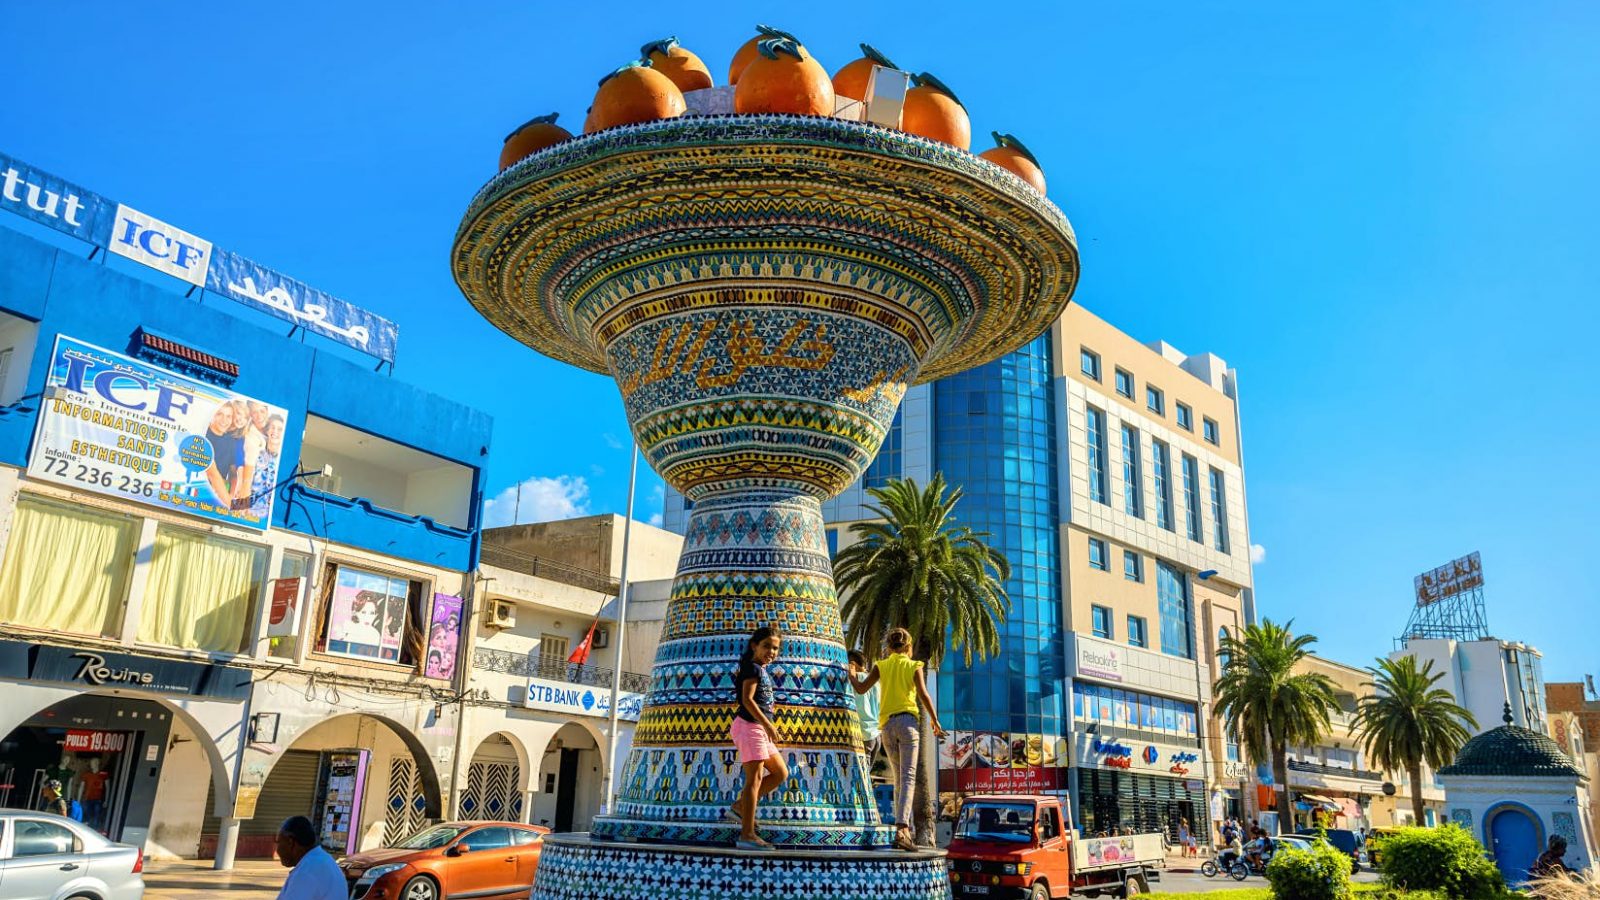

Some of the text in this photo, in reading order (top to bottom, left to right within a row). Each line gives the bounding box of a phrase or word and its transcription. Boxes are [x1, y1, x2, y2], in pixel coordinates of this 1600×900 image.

[1, 167, 85, 226] tut
[118, 217, 204, 270] ICF
[228, 276, 370, 346] معهد
[58, 353, 194, 422] ICF
[53, 400, 167, 442] INFORMATIQUE
[100, 401, 188, 432] Internationale
[45, 447, 77, 461] Infoline
[70, 439, 160, 475] ESTHETIQUE
[117, 435, 164, 459] SANTE
[44, 456, 154, 497] 72 236 236
[75, 652, 154, 685] Rouine
[528, 683, 580, 706] STB BANK
[66, 731, 124, 752] PULLS 19.900
